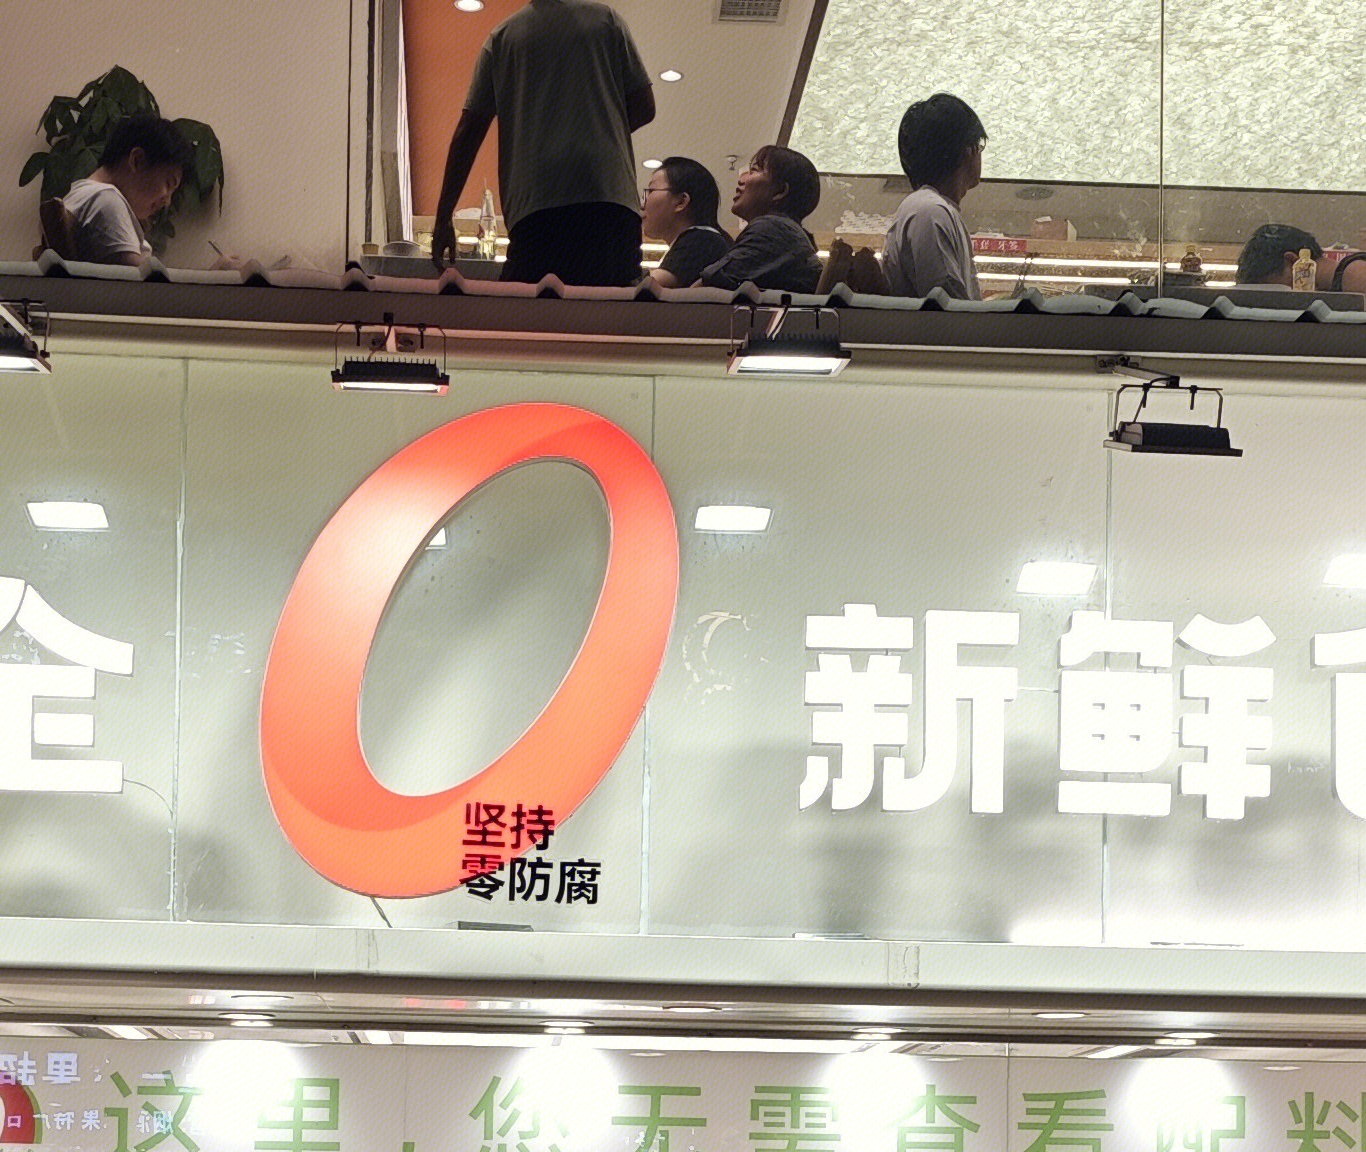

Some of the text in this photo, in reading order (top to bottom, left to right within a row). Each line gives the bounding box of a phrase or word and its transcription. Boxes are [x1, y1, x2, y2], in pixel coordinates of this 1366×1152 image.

[461, 801, 556, 853] 坚持
[459, 853, 602, 907] 零防腐
